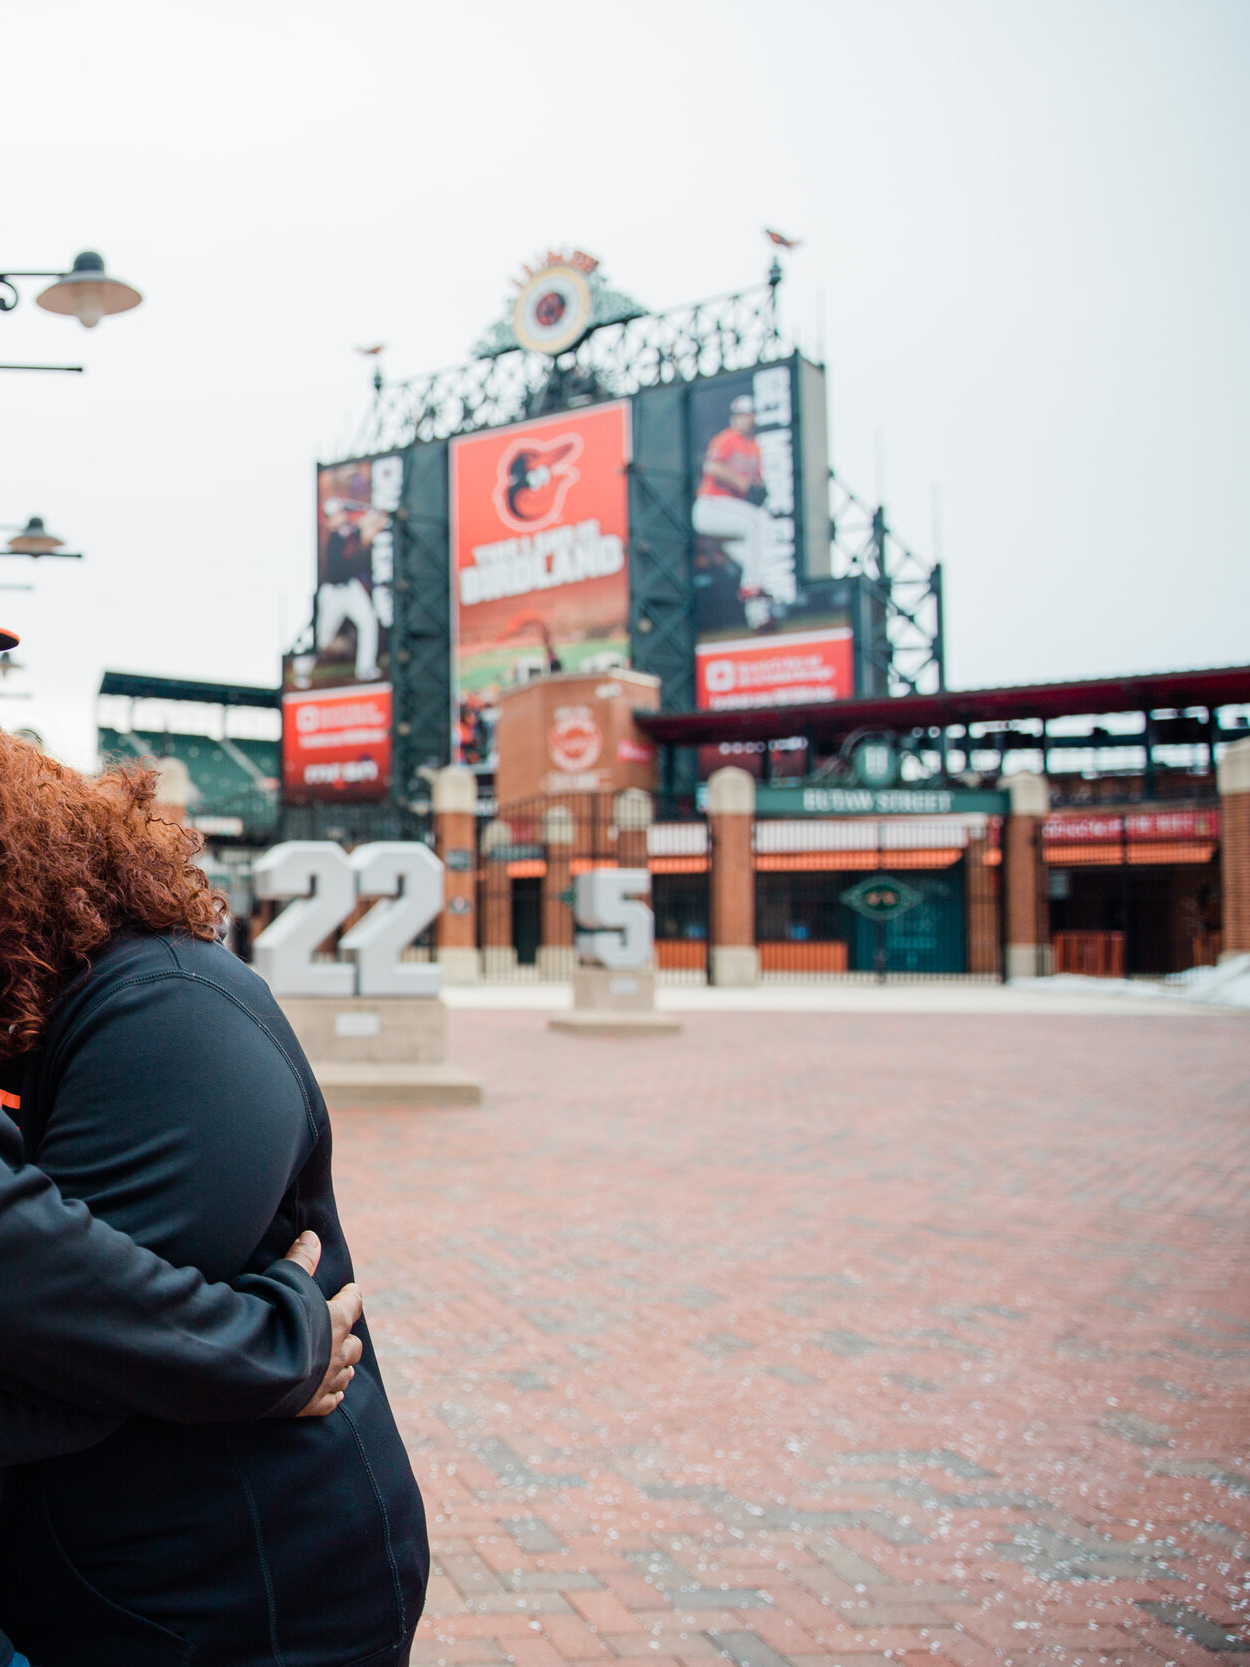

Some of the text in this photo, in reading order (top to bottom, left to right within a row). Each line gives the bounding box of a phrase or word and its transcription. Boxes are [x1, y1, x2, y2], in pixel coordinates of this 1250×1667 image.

[460, 534, 624, 606] BIRDLAND
[804, 789, 953, 812] EUTAW STREET
[253, 840, 444, 996] 22
[575, 867, 654, 970] 5
